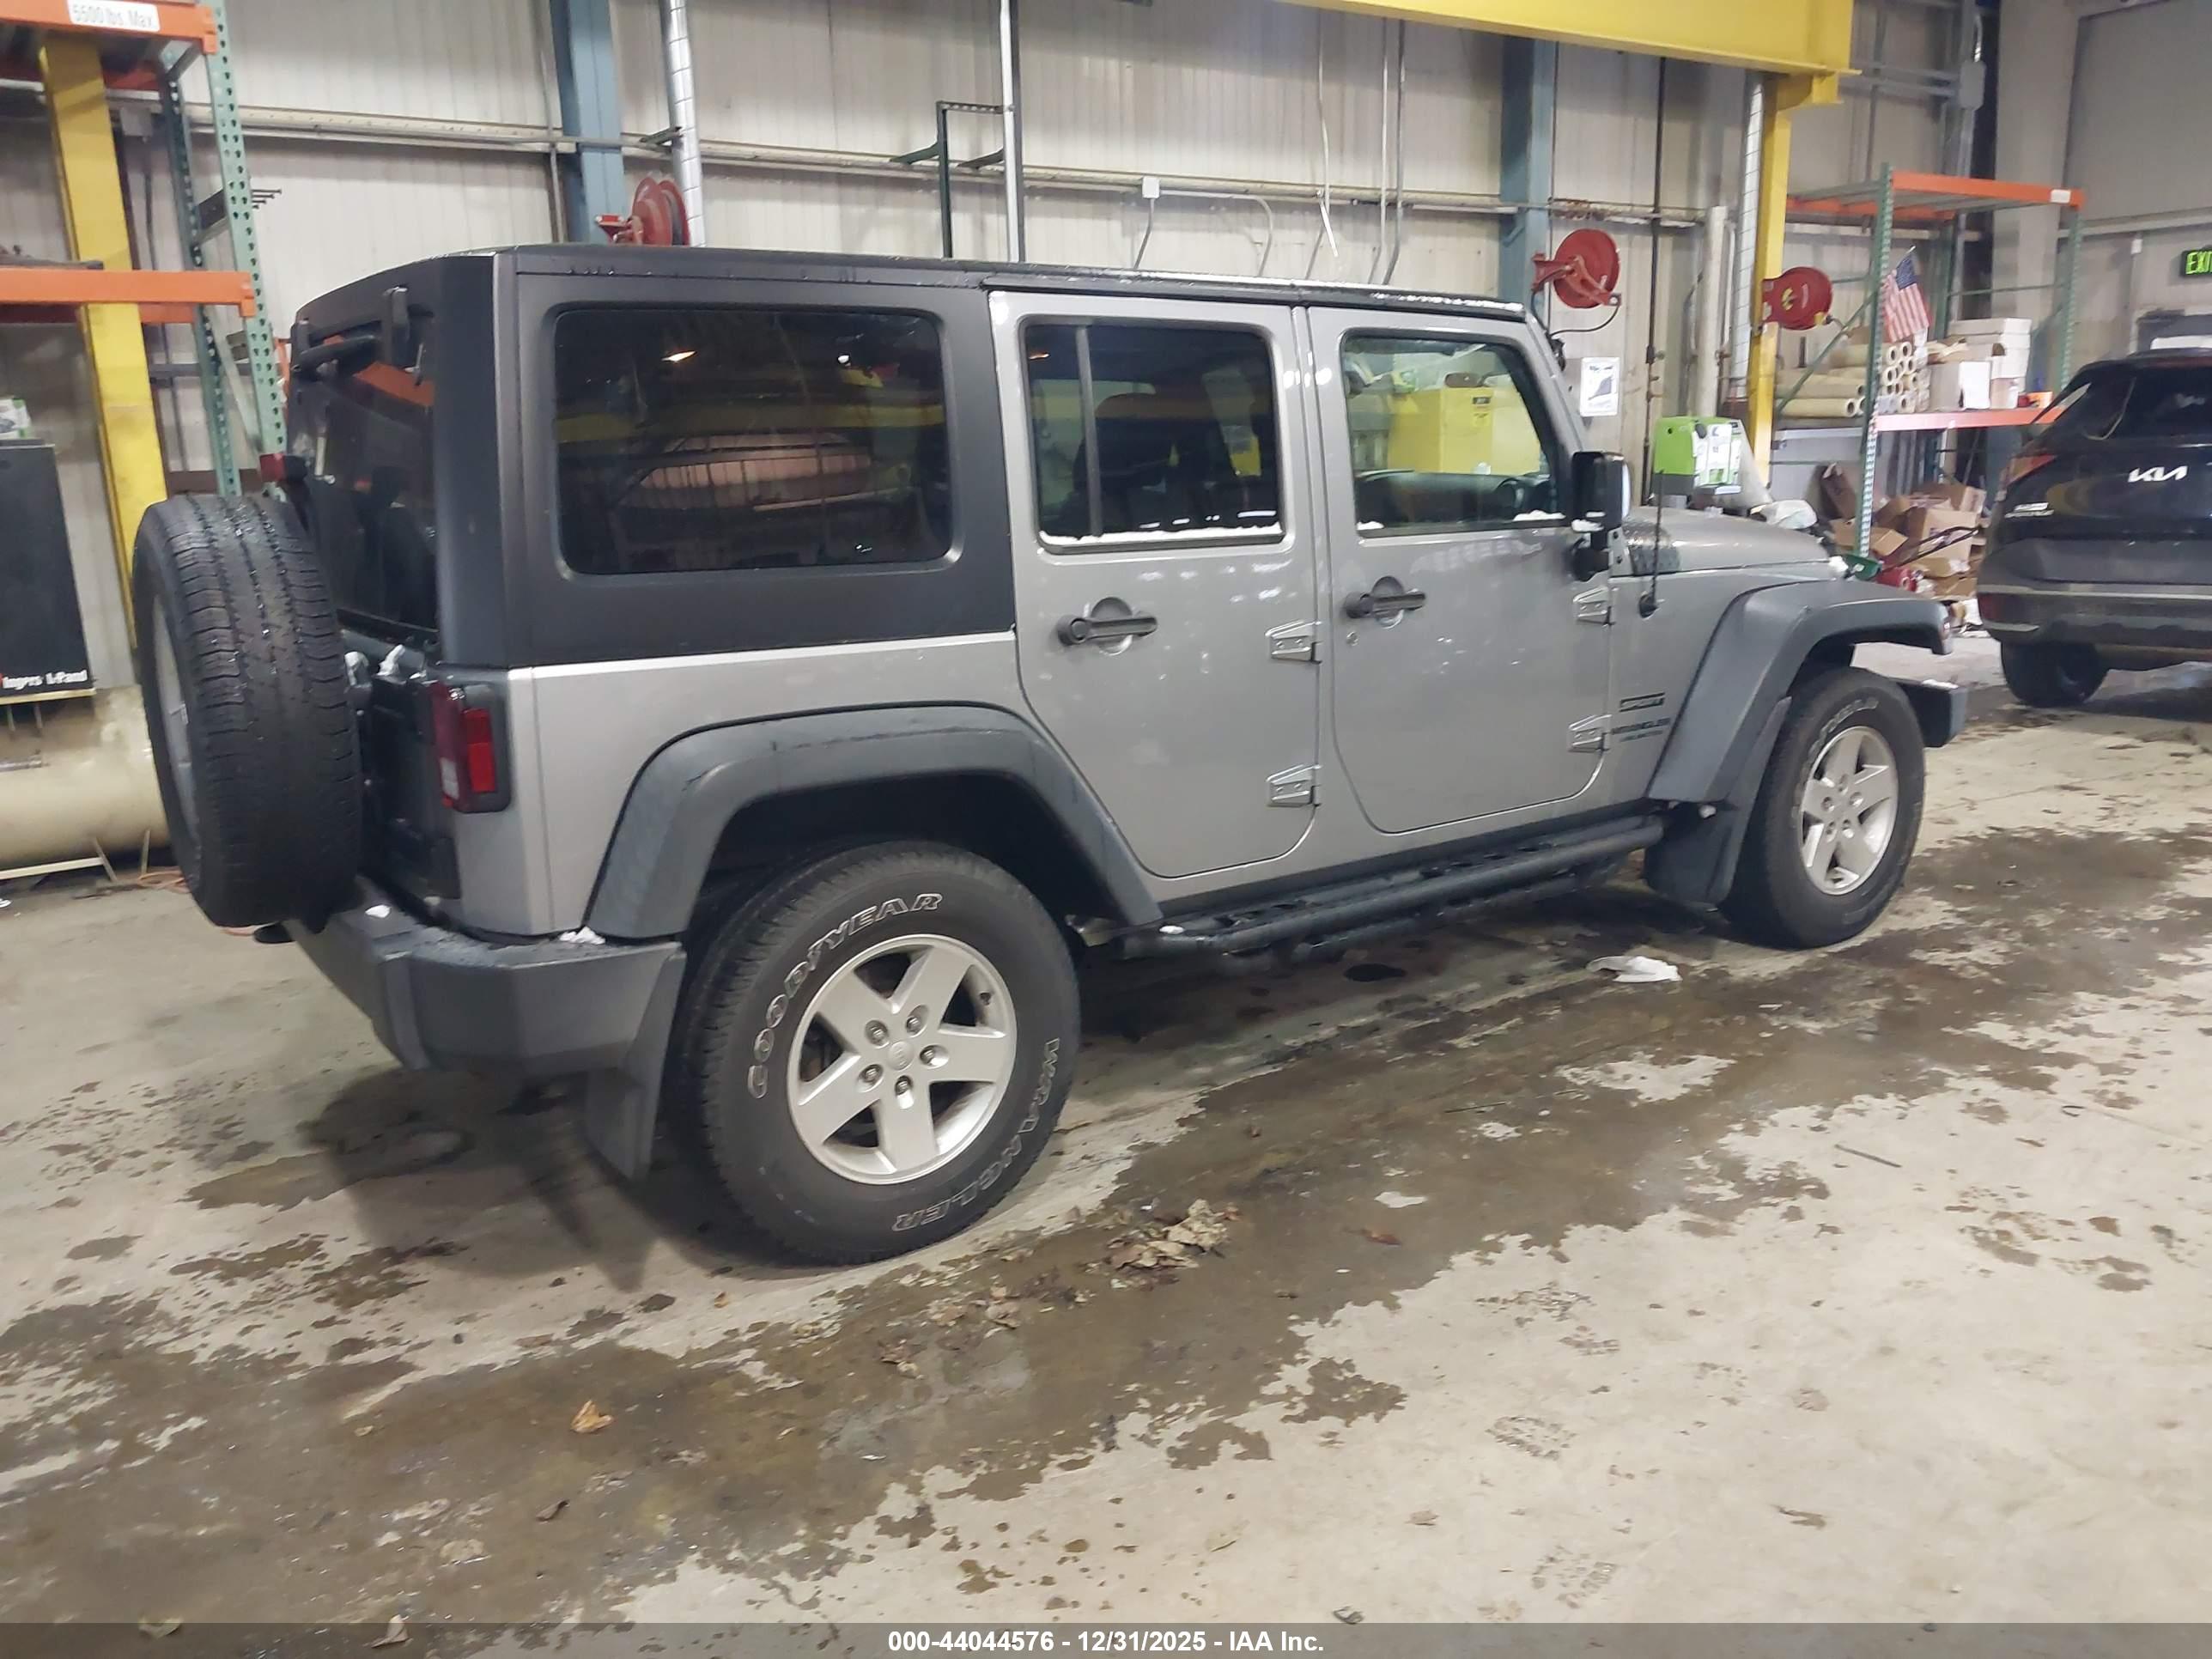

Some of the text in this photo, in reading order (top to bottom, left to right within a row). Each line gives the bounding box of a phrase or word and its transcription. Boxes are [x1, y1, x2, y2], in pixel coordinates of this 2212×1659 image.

[72, 3, 105, 23] 5500
[747, 892, 943, 1099] GOODYEAR
[891, 1037, 1060, 1231] WRANGLER
